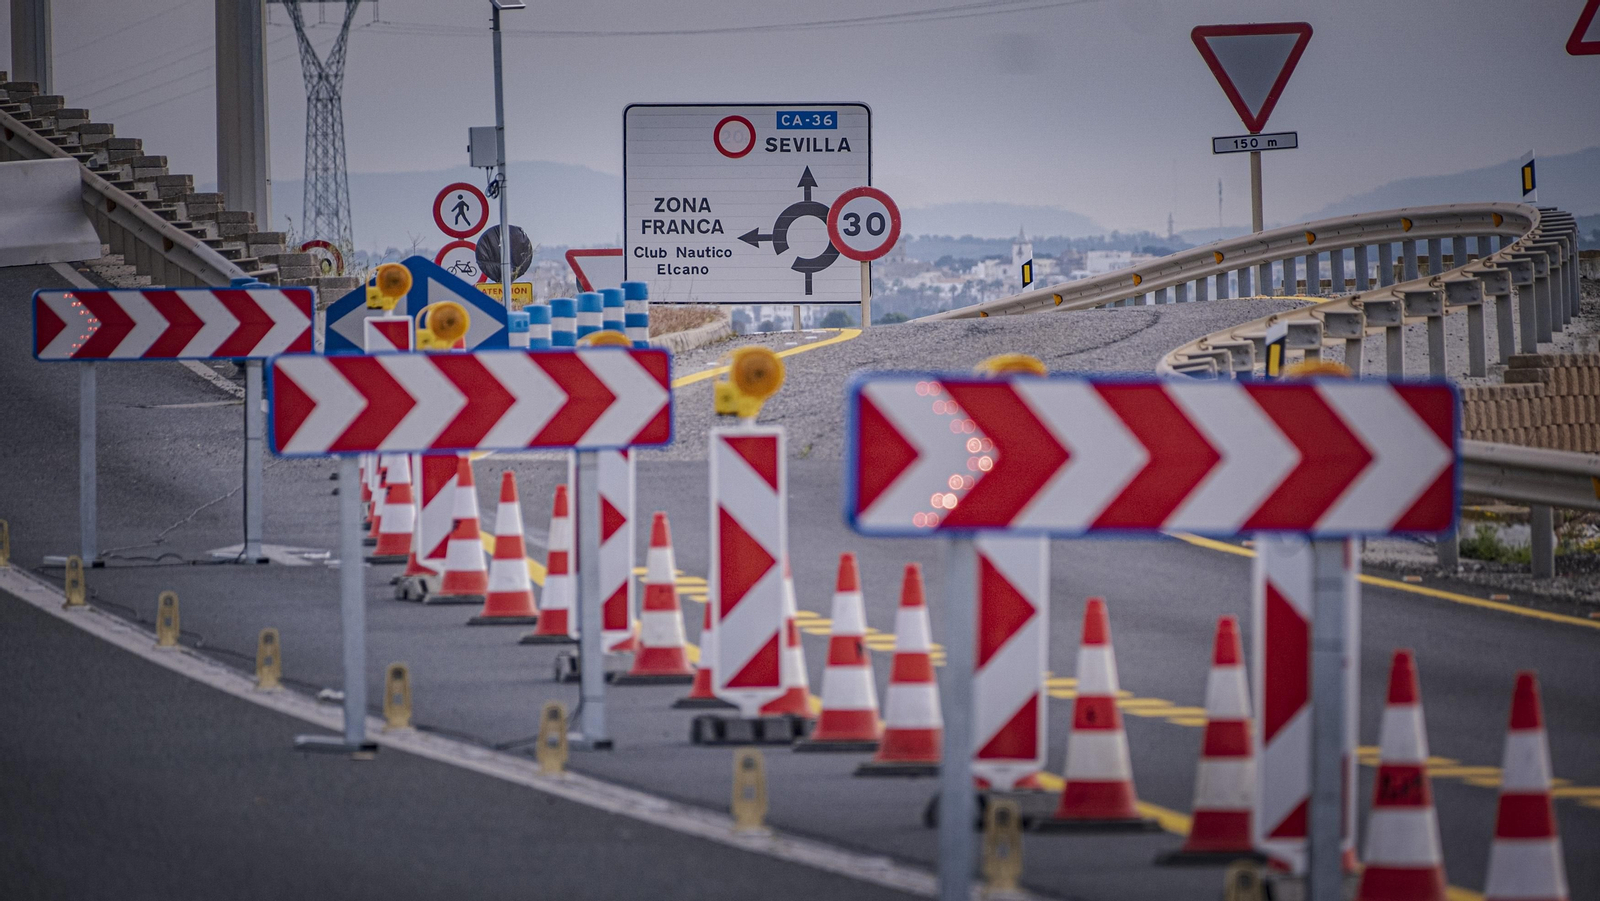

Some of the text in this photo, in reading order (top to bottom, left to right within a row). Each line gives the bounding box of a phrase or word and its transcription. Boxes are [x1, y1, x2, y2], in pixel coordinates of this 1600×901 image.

[781, 114, 833, 126] CA-36
[764, 136, 852, 153] SEVILLA
[1234, 138, 1277, 149] 150 m
[653, 196, 712, 213] ZONA
[641, 218, 725, 235] FRANCA
[842, 211, 887, 237] 30
[633, 246, 733, 259] Club Nautico
[657, 263, 710, 276] Elcano
